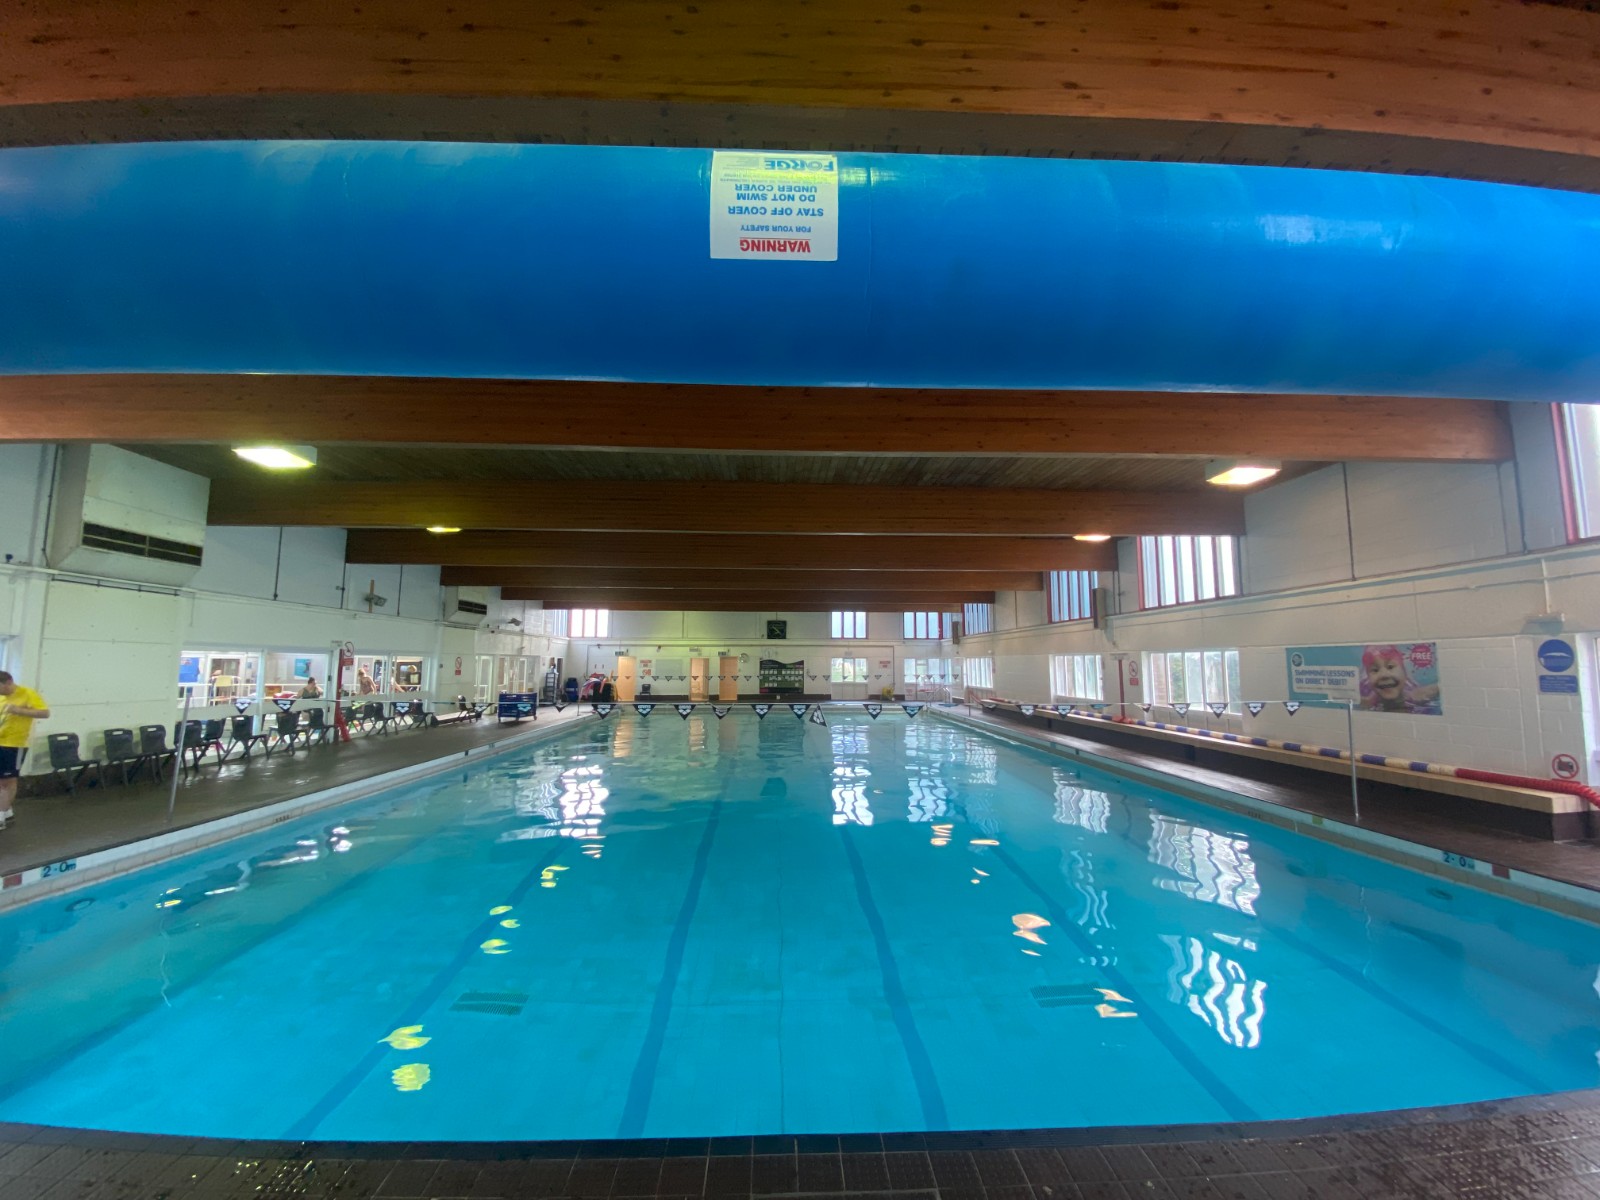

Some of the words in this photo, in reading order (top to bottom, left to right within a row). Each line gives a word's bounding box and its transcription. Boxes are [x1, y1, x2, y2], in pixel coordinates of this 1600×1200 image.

[734, 184, 774, 192] COVER
[736, 192, 768, 202] SWIM
[771, 193, 795, 202] NOT
[798, 194, 816, 202] DO
[728, 206, 768, 216] COVER
[770, 206, 793, 216] OFF
[796, 207, 824, 217] STAY
[740, 224, 770, 232] SAFETY
[796, 225, 811, 233] FOR
[740, 239, 811, 253] WARNING
[1411, 652, 1432, 660] FREE
